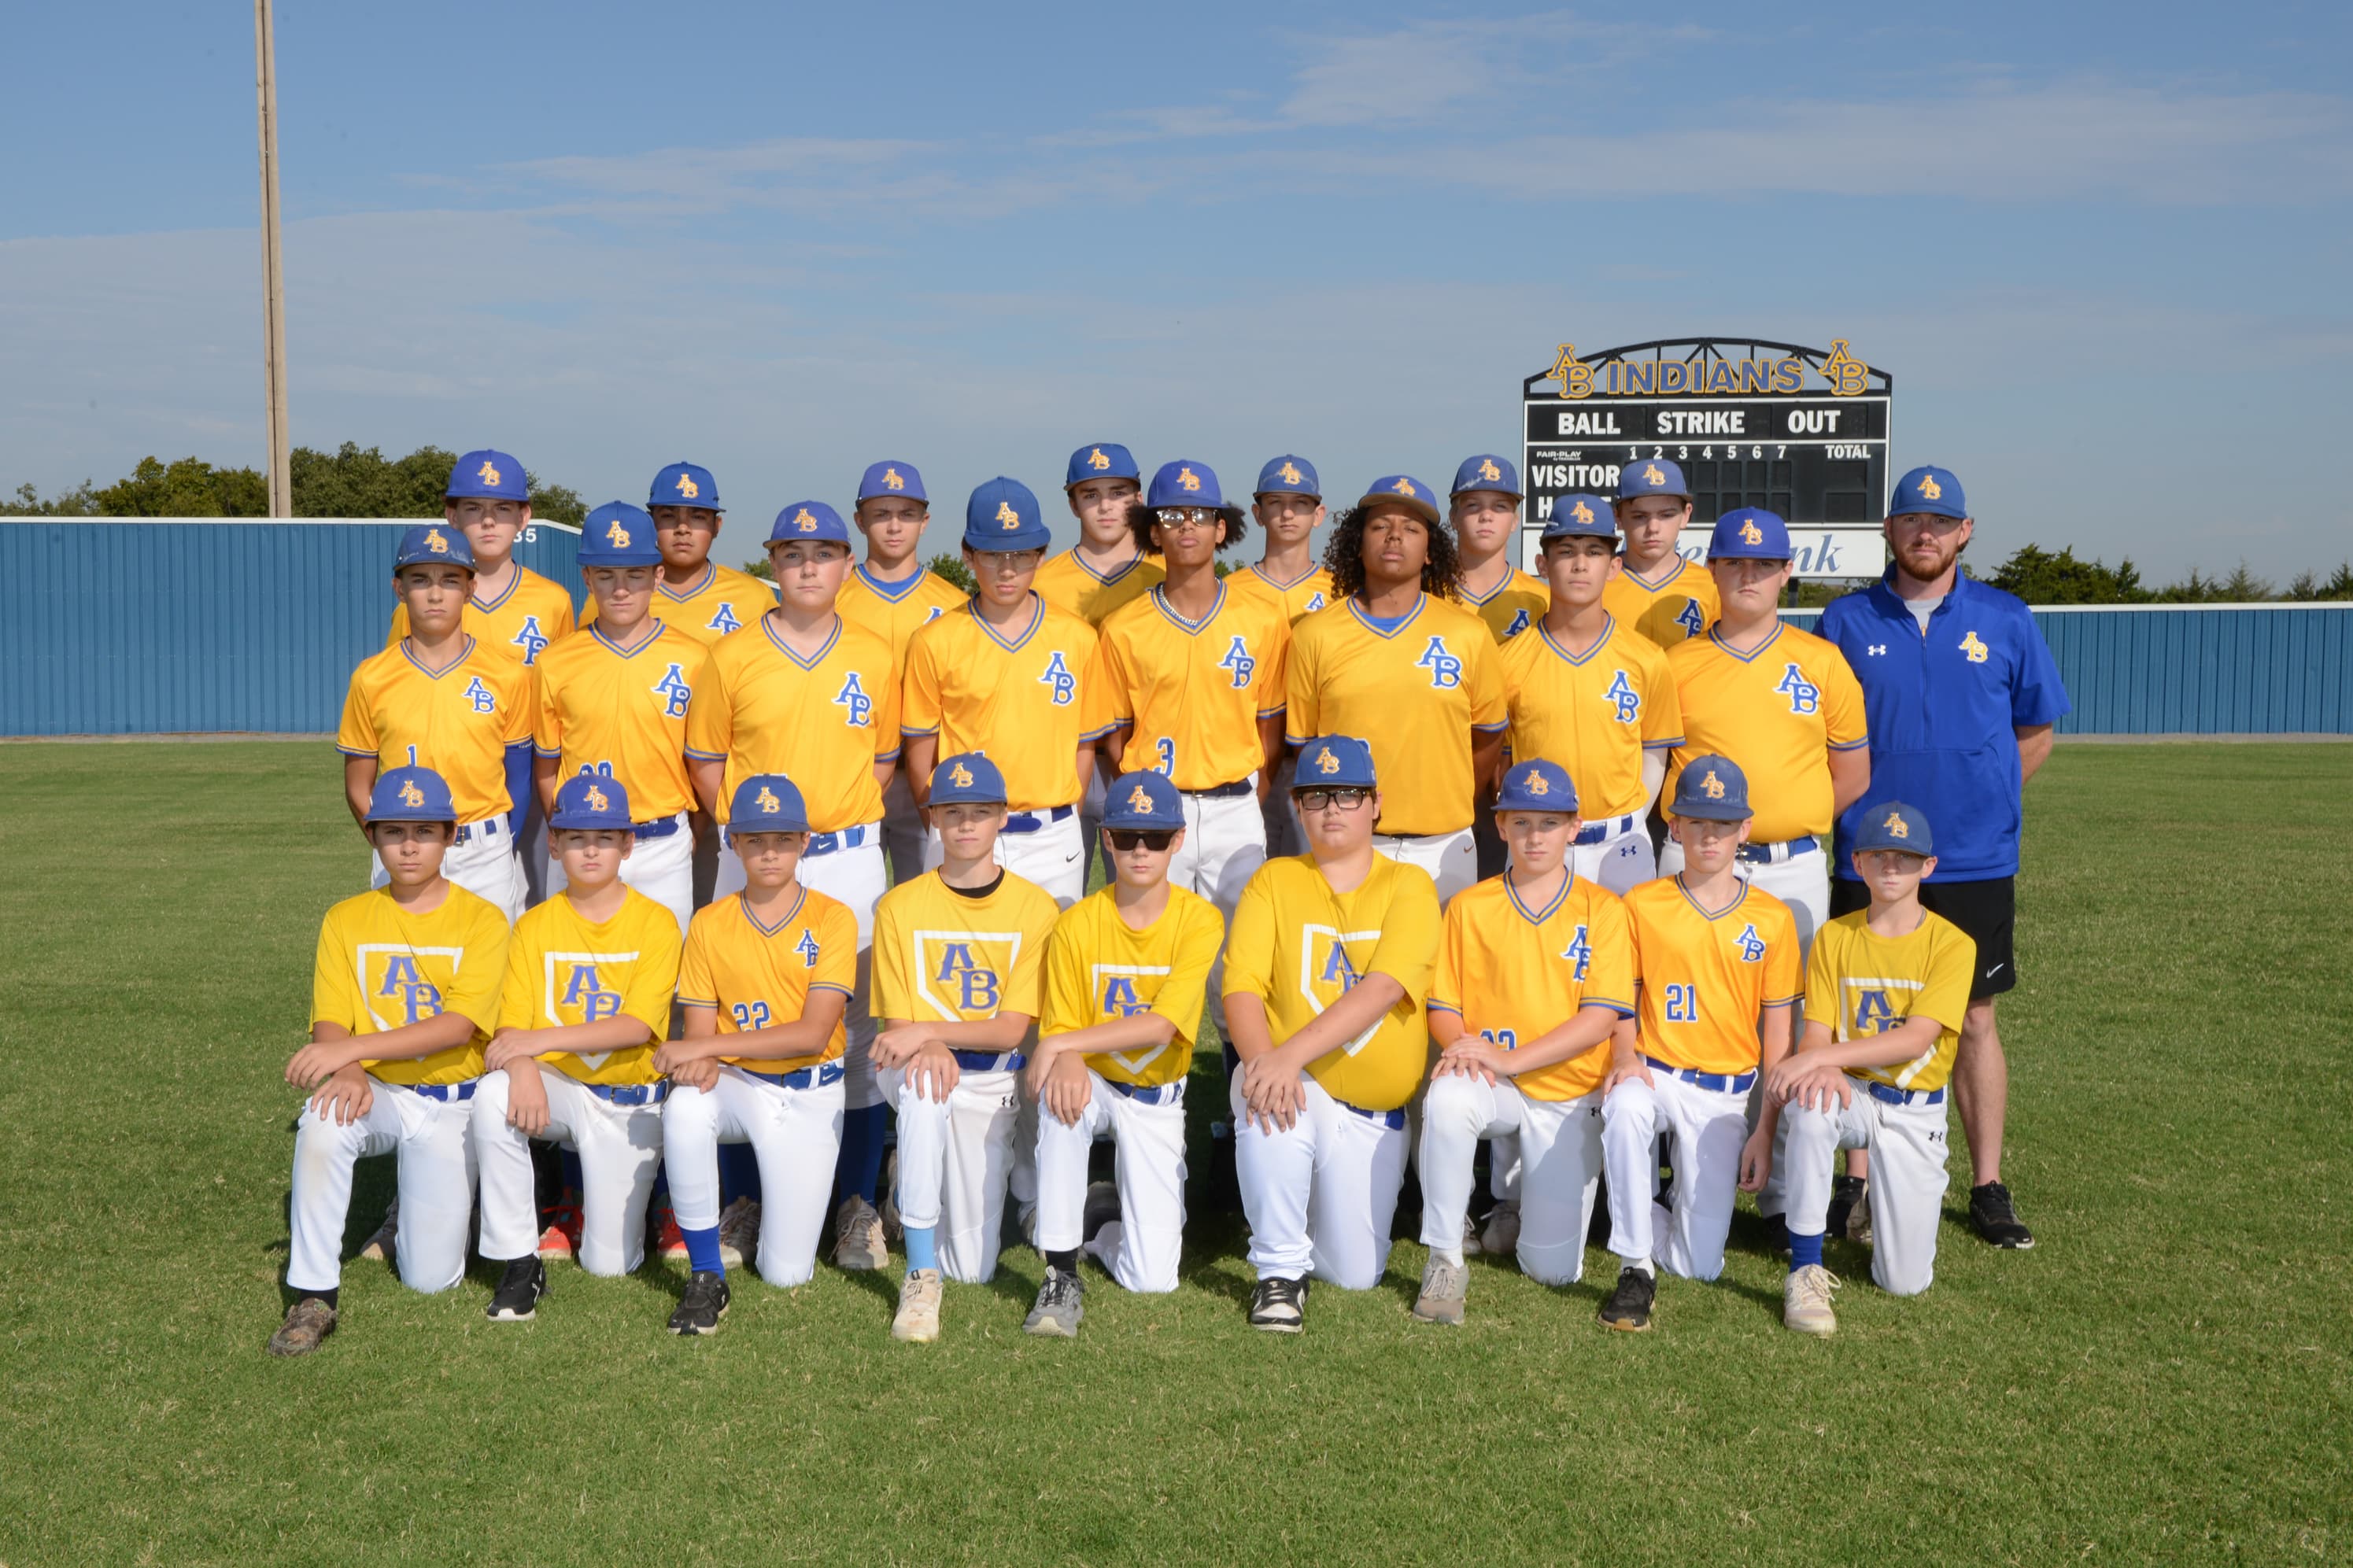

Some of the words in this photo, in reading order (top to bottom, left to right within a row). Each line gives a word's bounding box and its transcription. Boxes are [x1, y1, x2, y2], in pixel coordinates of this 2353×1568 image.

[1546, 344, 1595, 399] AB
[1607, 357, 1804, 395] INDIANS
[1818, 339, 1869, 396] AB
[1558, 412, 1621, 434] BALL
[1657, 411, 1745, 434] STRIKE
[1787, 410, 1841, 434] OUT
[1630, 446, 1637, 459] 1
[1653, 446, 1663, 459] 2
[1679, 446, 1688, 459] 3
[1702, 445, 1712, 459] 4
[1727, 445, 1737, 459] 5
[1752, 445, 1762, 459] 6
[1778, 445, 1786, 459] 7
[1825, 445, 1871, 459] TOTAL
[1531, 464, 1620, 488] VISITOR
[705, 602, 743, 636] A
[1217, 635, 1255, 688] AB
[1413, 635, 1462, 689] AB
[1960, 631, 1989, 662] AB
[461, 677, 496, 714] AB
[650, 662, 693, 719] AB
[830, 671, 872, 727] AB
[1038, 651, 1077, 707] AB
[1601, 670, 1642, 724] AB
[1773, 662, 1820, 716] AB
[1154, 736, 1175, 779] 3
[1733, 923, 1766, 963] AB
[375, 954, 445, 1024] AB
[934, 940, 1003, 1013] AB
[1103, 975, 1152, 1017] A
[732, 1001, 770, 1032] 22
[1665, 983, 1697, 1022] 21
